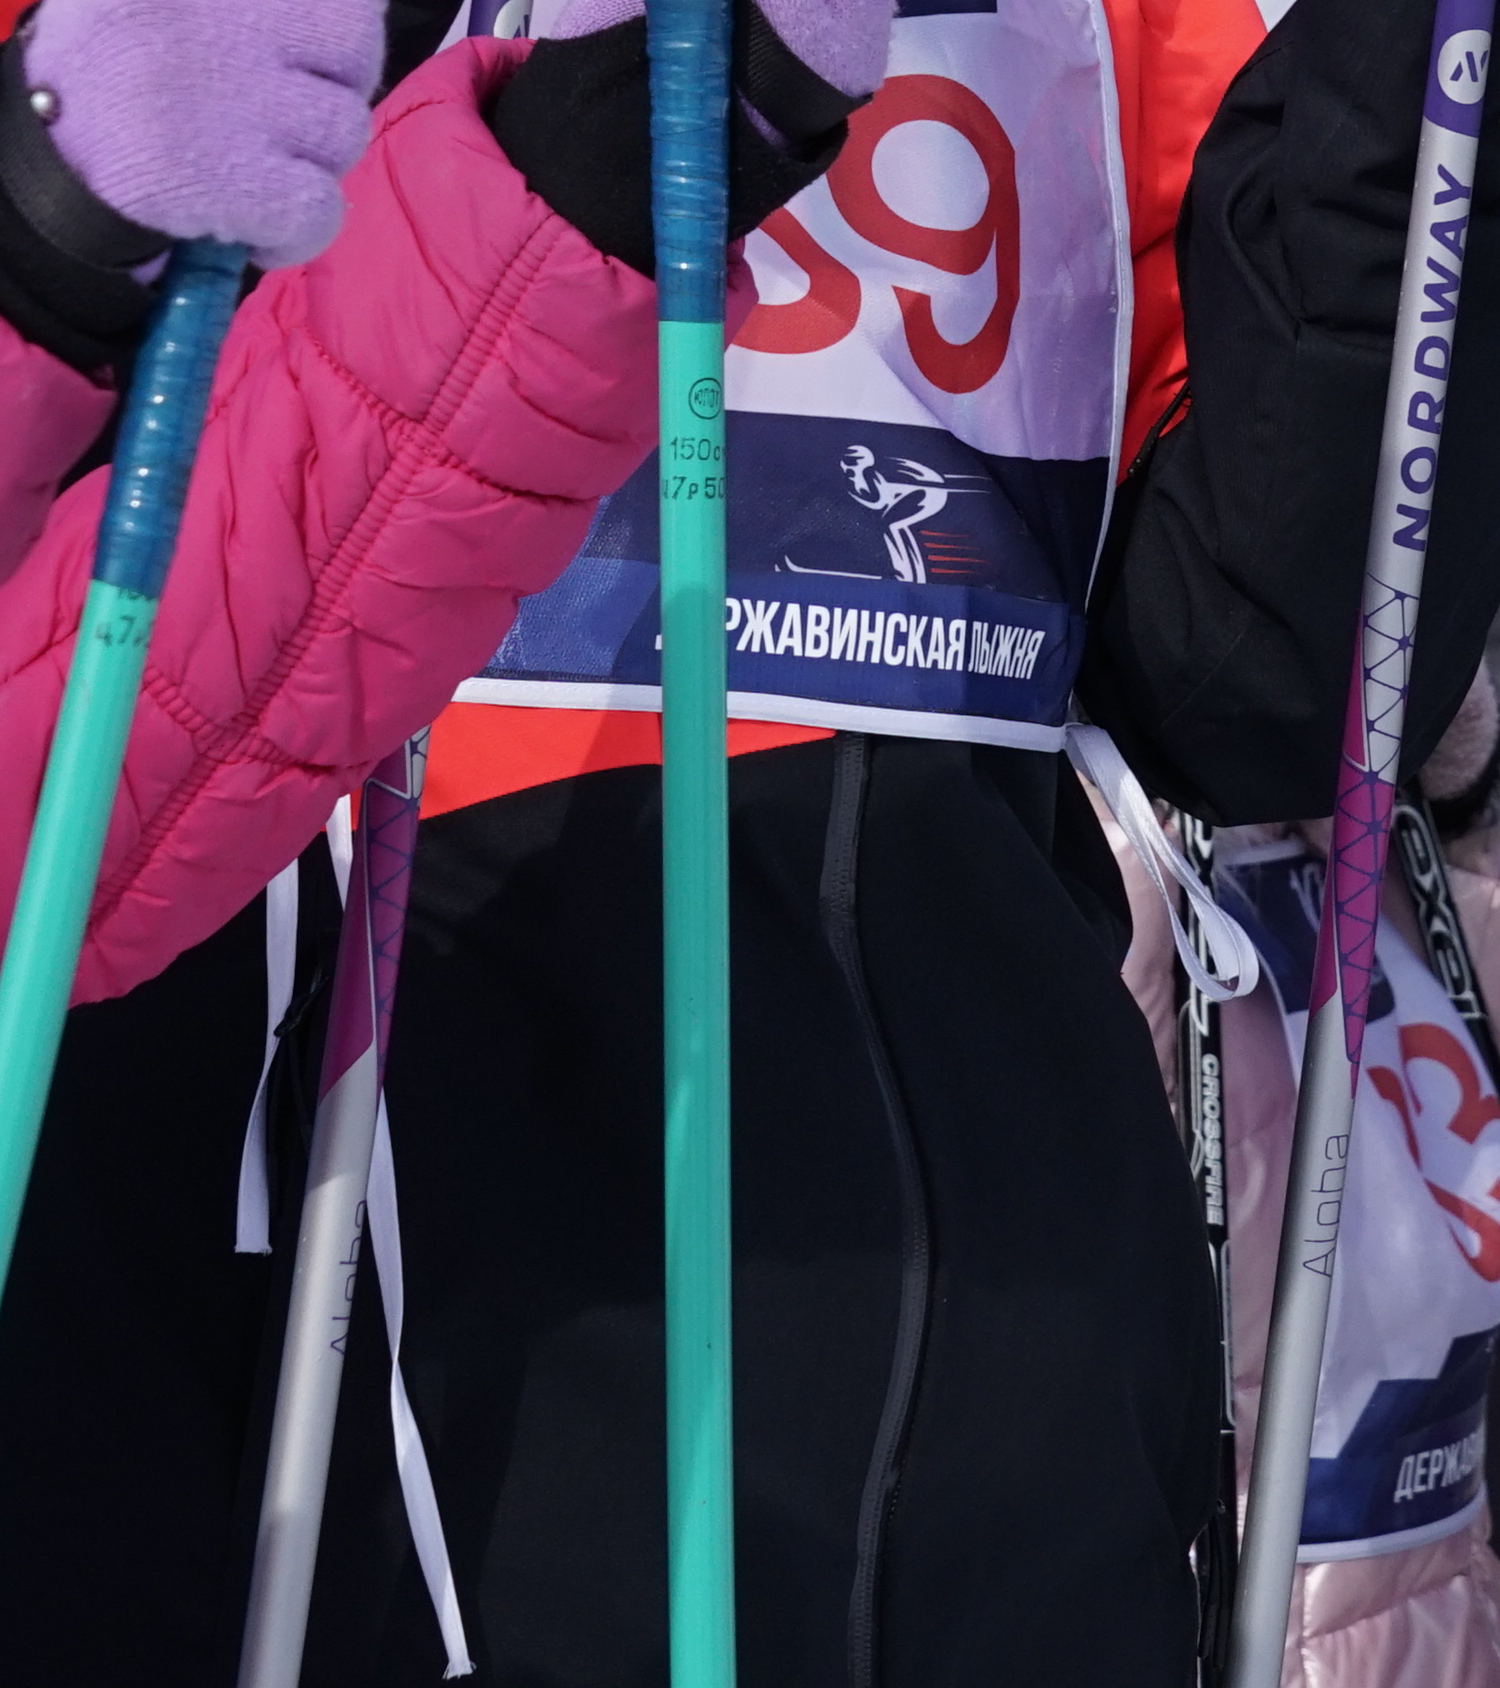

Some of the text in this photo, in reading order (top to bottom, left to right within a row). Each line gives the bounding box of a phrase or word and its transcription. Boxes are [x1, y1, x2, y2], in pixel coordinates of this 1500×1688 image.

[1392, 164, 1472, 552] NORDWAY
[967, 620, 1047, 681] ЛЫЖНЯ
[1302, 1134, 1350, 1278] Aloha
